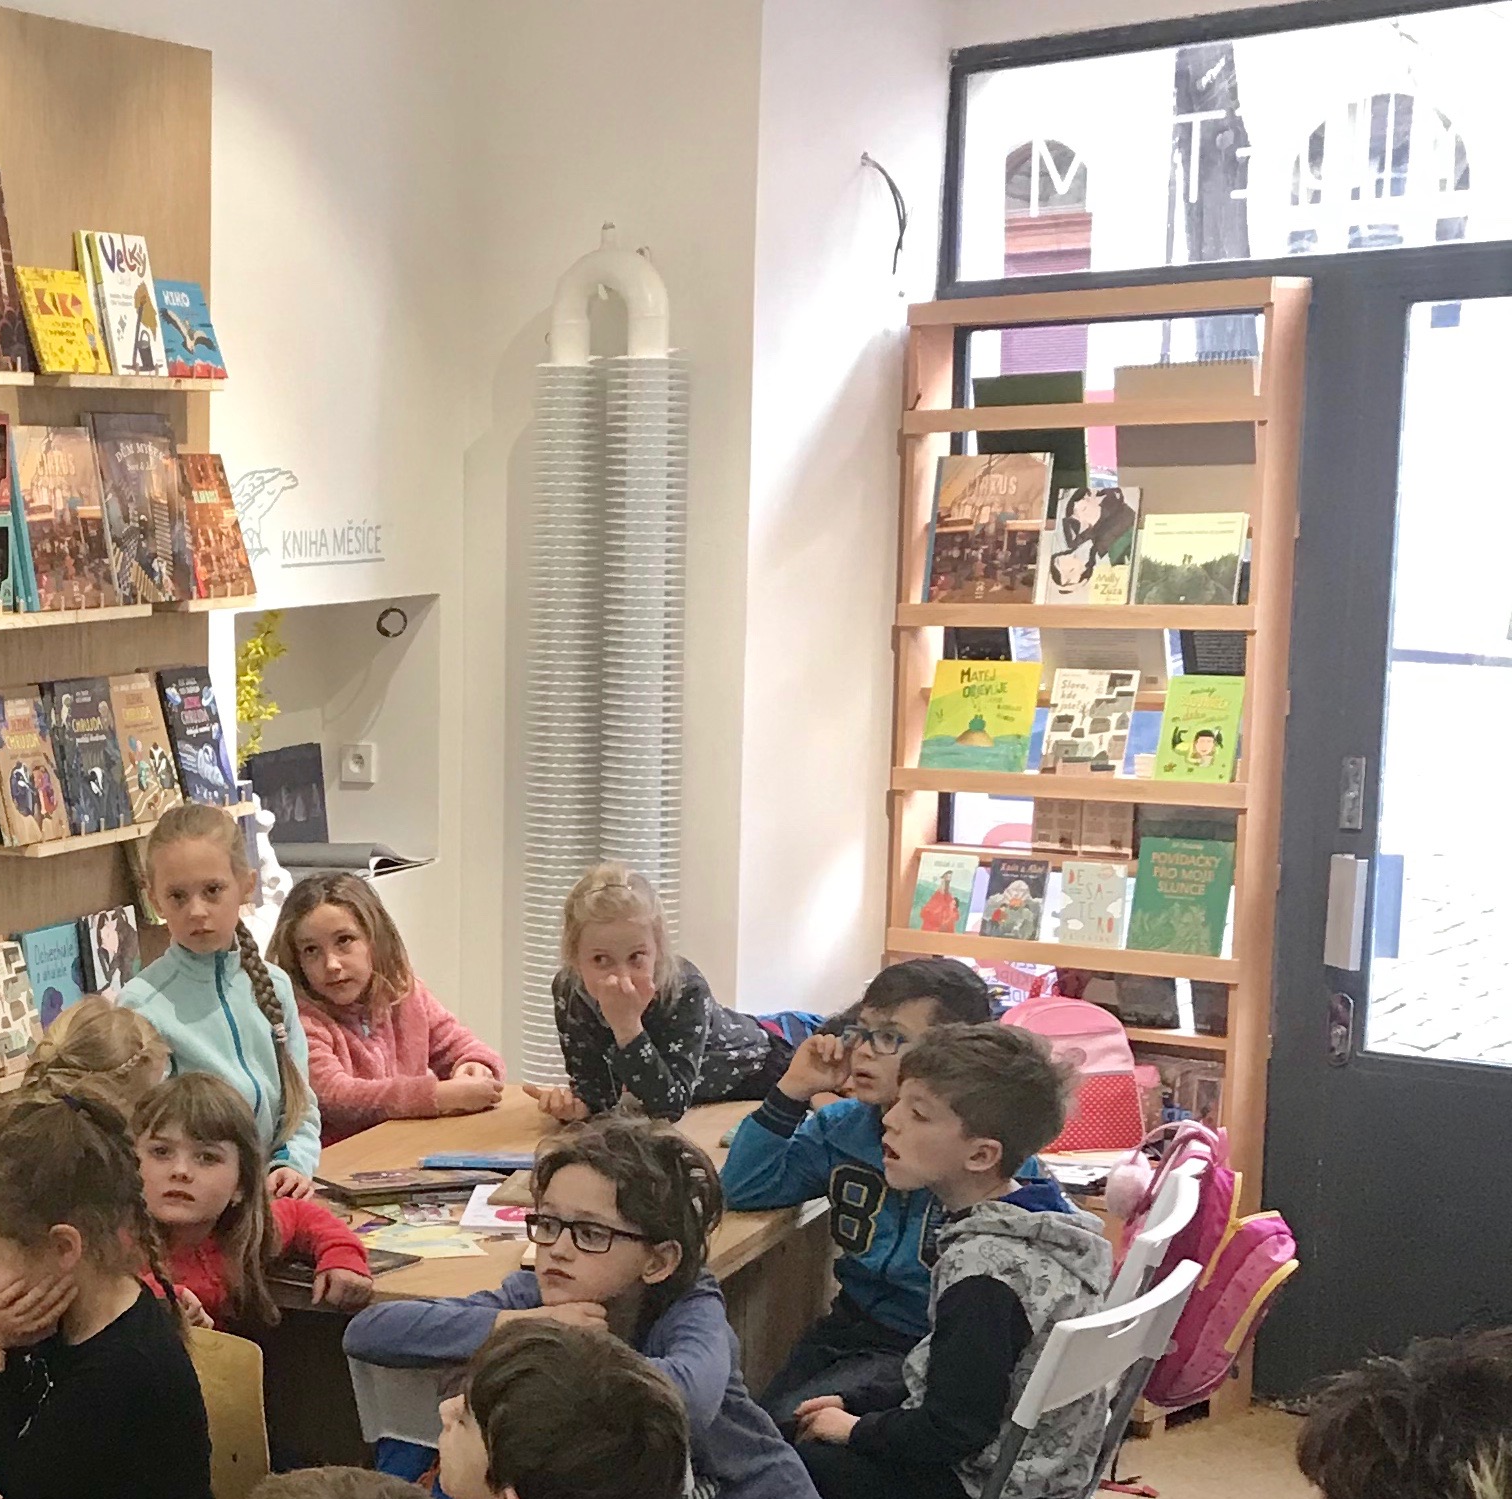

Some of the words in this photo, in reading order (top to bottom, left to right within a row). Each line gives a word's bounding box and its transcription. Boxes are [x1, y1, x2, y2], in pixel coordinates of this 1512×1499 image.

[98, 233, 147, 278] Velký
[281, 527, 329, 560] KNIHA
[332, 518, 382, 555] MĚSÍCE
[1157, 880, 1206, 896] SLUNCE
[828, 1162, 887, 1256] 8
